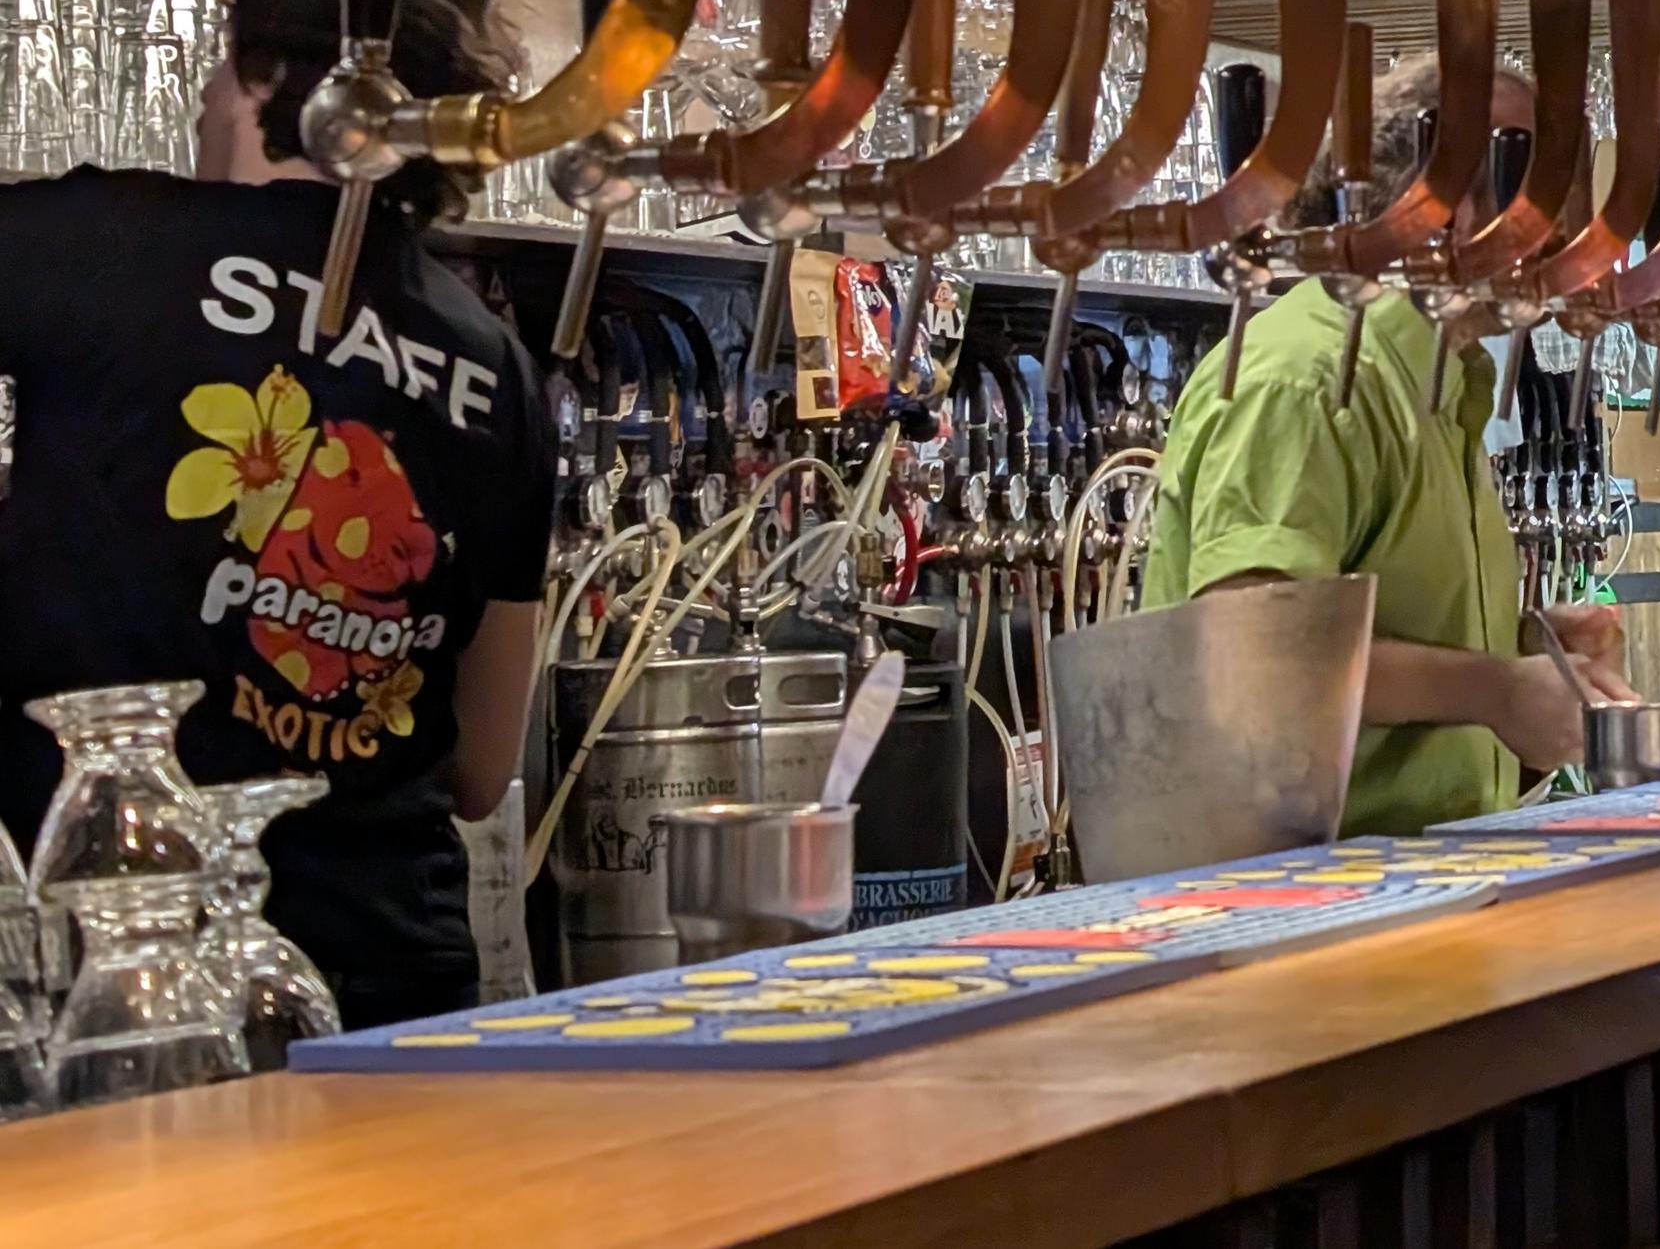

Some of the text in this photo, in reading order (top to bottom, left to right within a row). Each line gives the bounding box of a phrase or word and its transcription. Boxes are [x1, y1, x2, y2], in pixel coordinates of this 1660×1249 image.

[200, 255, 500, 431] STAFF
[200, 555, 447, 660] paranoia
[231, 672, 381, 762] EXOTIC
[854, 877, 955, 908] BRASSERIE
